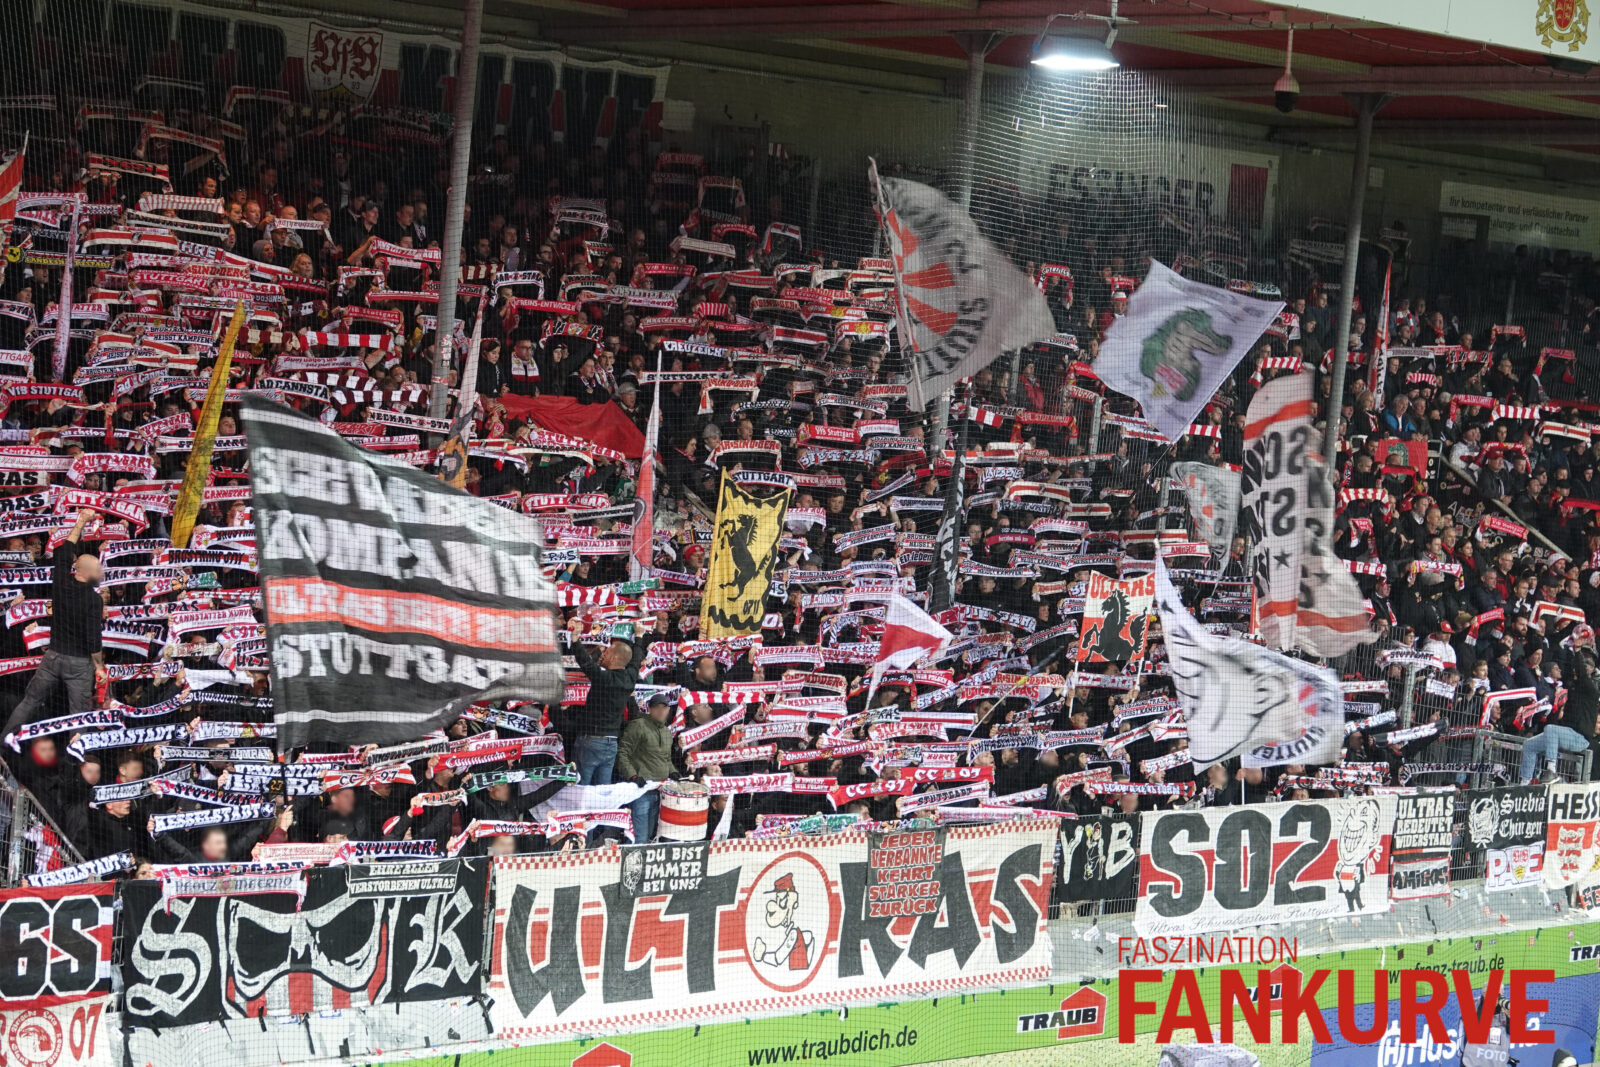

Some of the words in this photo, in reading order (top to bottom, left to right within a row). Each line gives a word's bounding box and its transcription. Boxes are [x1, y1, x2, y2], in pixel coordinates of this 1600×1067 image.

[1449, 196, 1459, 207] Ihr
[1461, 198, 1506, 213] kompetenter
[1507, 205, 1520, 216] und
[1564, 211, 1589, 223] Partner
[369, 413, 412, 425] NECKAR
[828, 428, 855, 441] Stuttgart
[733, 471, 792, 485] STUTTGART
[110, 541, 170, 555] STUTTGART
[1091, 572, 1155, 600] ULTRAS
[199, 723, 240, 737] WEST
[507, 714, 538, 732] RAS
[533, 736, 557, 746] KURVE
[340, 776, 358, 786] CC
[381, 771, 398, 783] 97
[711, 774, 786, 788] STUTTGART
[915, 769, 938, 781] CC
[176, 785, 263, 806] STUTTGART
[845, 784, 867, 798] CC
[1399, 796, 1455, 819] ULTRAS
[1500, 793, 1546, 815] Suebia
[153, 805, 260, 833] KESSELSTADT
[1397, 816, 1454, 835] BEDEUTET
[880, 831, 936, 849] JEDER
[1394, 833, 1453, 849] WIDERSTAND
[646, 848, 667, 863] DU
[672, 845, 705, 861] BIST
[870, 846, 942, 869] VERBANNTE
[28, 855, 121, 887] KESSELSTADT
[369, 864, 400, 876] EHRE
[402, 862, 440, 875] ALLEN
[644, 862, 702, 879] IMMER
[877, 866, 935, 884] KEHRT
[350, 879, 420, 895] VERSTORBENEN
[421, 877, 455, 891] ULTRAS
[643, 880, 665, 893] BEI
[669, 878, 701, 891] UNS!
[869, 898, 937, 917] ZURÜCK
[1285, 904, 1340, 922] Stuttgart
[1018, 1006, 1098, 1032] TRAUB
[69, 1002, 104, 1062] 07
[748, 1024, 918, 1067] www.traubdich.de
[1477, 1046, 1507, 1064] FOTO
